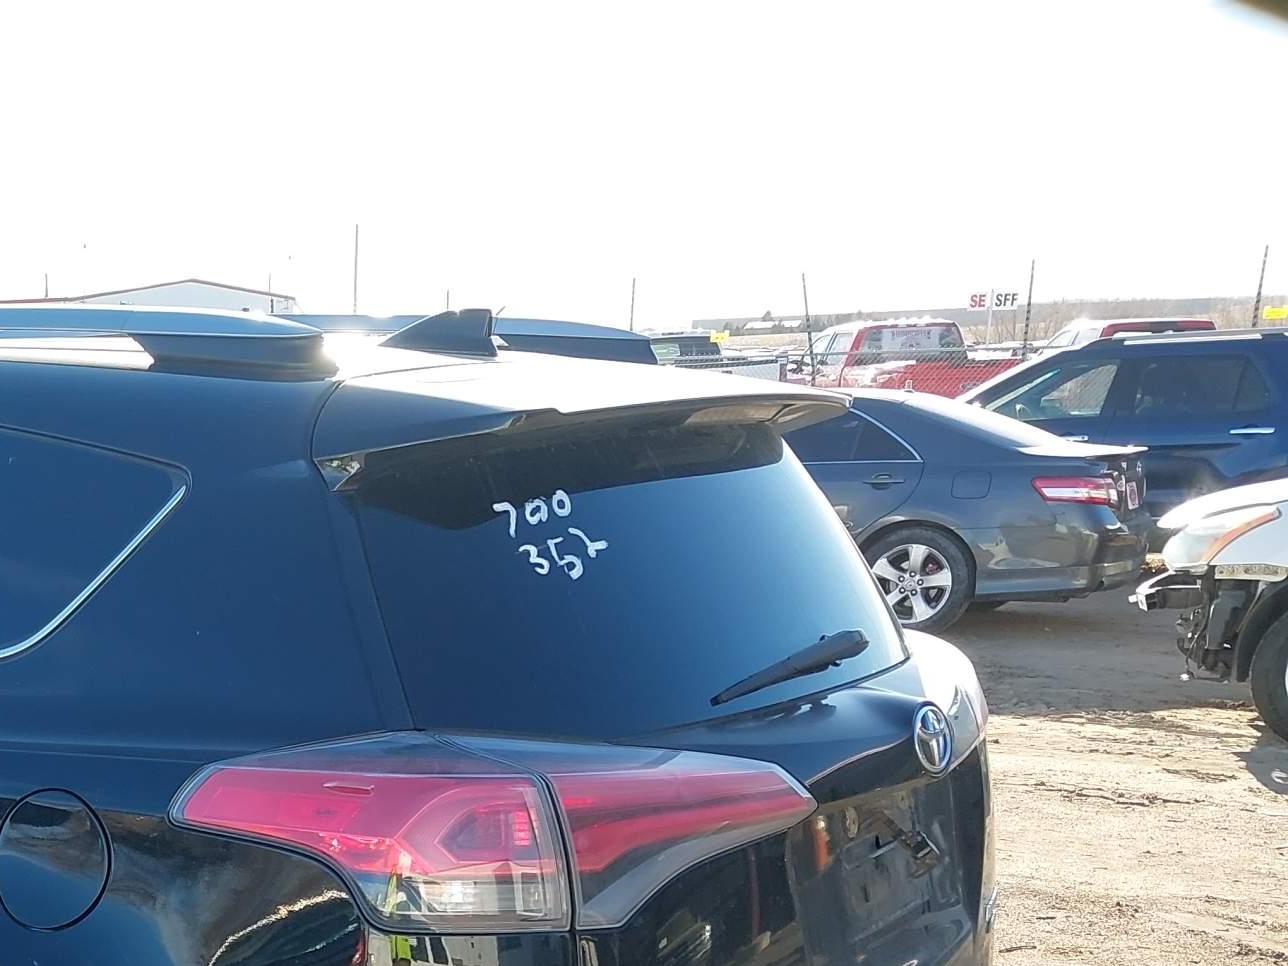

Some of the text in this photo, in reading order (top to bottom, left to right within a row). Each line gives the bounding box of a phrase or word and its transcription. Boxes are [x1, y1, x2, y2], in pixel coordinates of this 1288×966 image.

[969, 294, 987, 308] SE
[995, 293, 1019, 307] SFF
[492, 488, 572, 538] 700
[518, 527, 609, 580] 352
